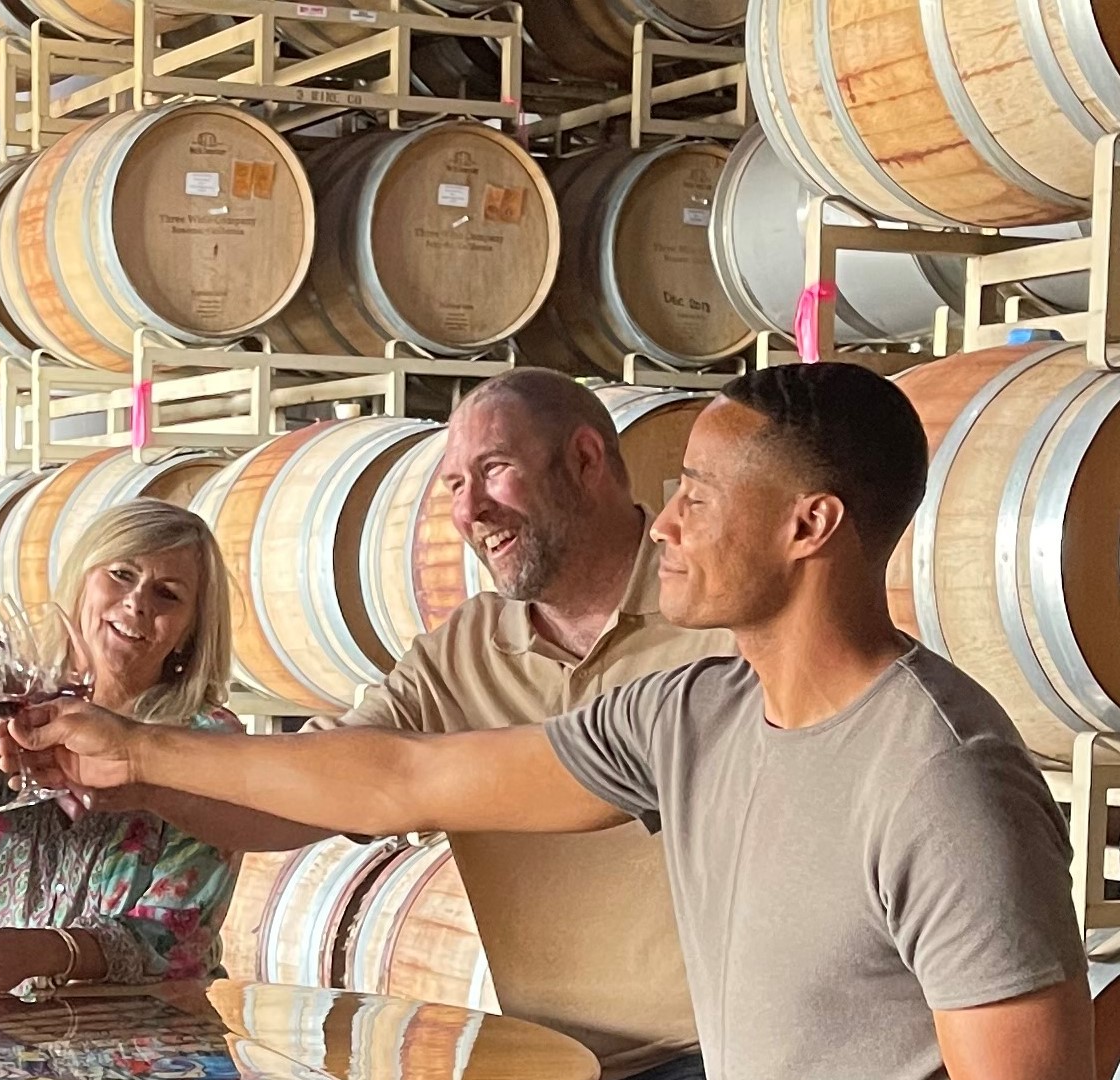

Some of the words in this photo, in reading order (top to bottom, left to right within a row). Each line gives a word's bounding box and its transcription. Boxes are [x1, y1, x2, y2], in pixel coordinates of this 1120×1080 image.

[296, 89, 304, 101] 3
[311, 91, 339, 103] WINE
[347, 94, 362, 105] CO
